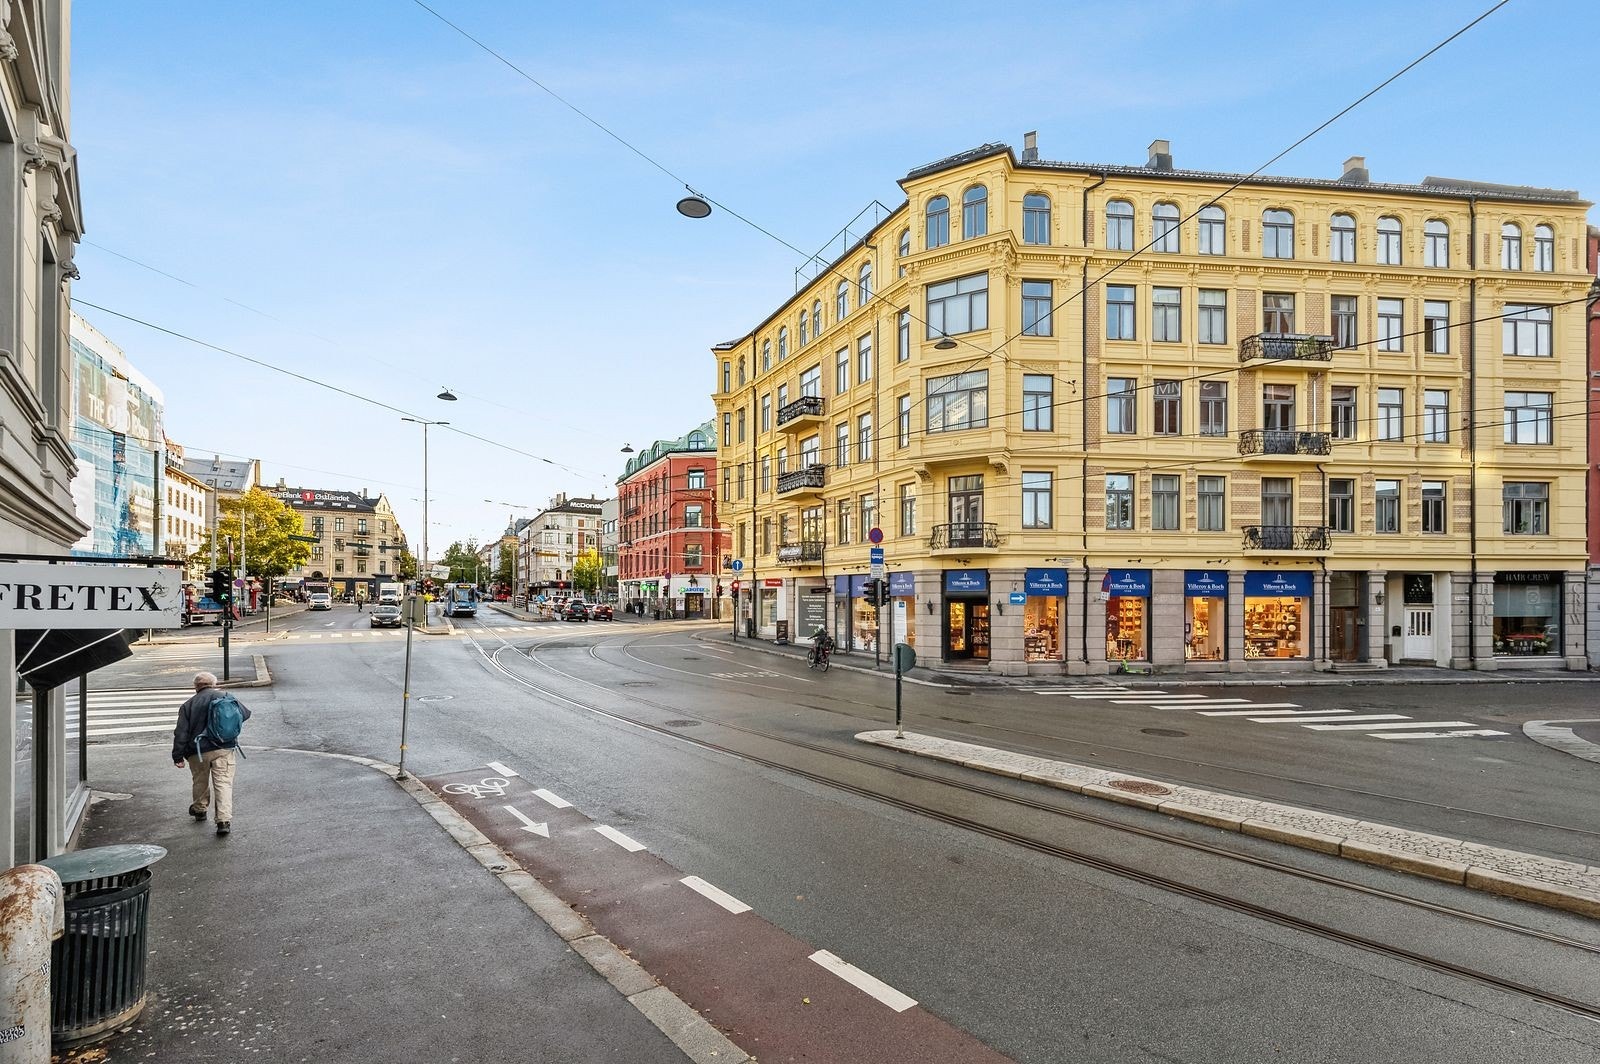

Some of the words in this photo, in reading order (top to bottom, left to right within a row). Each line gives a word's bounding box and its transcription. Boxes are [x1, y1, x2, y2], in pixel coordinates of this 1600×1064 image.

[88, 393, 105, 425] THE
[315, 493, 350, 502] Østlandet
[1505, 573, 1526, 581] HAIR
[1527, 573, 1550, 581] CREW
